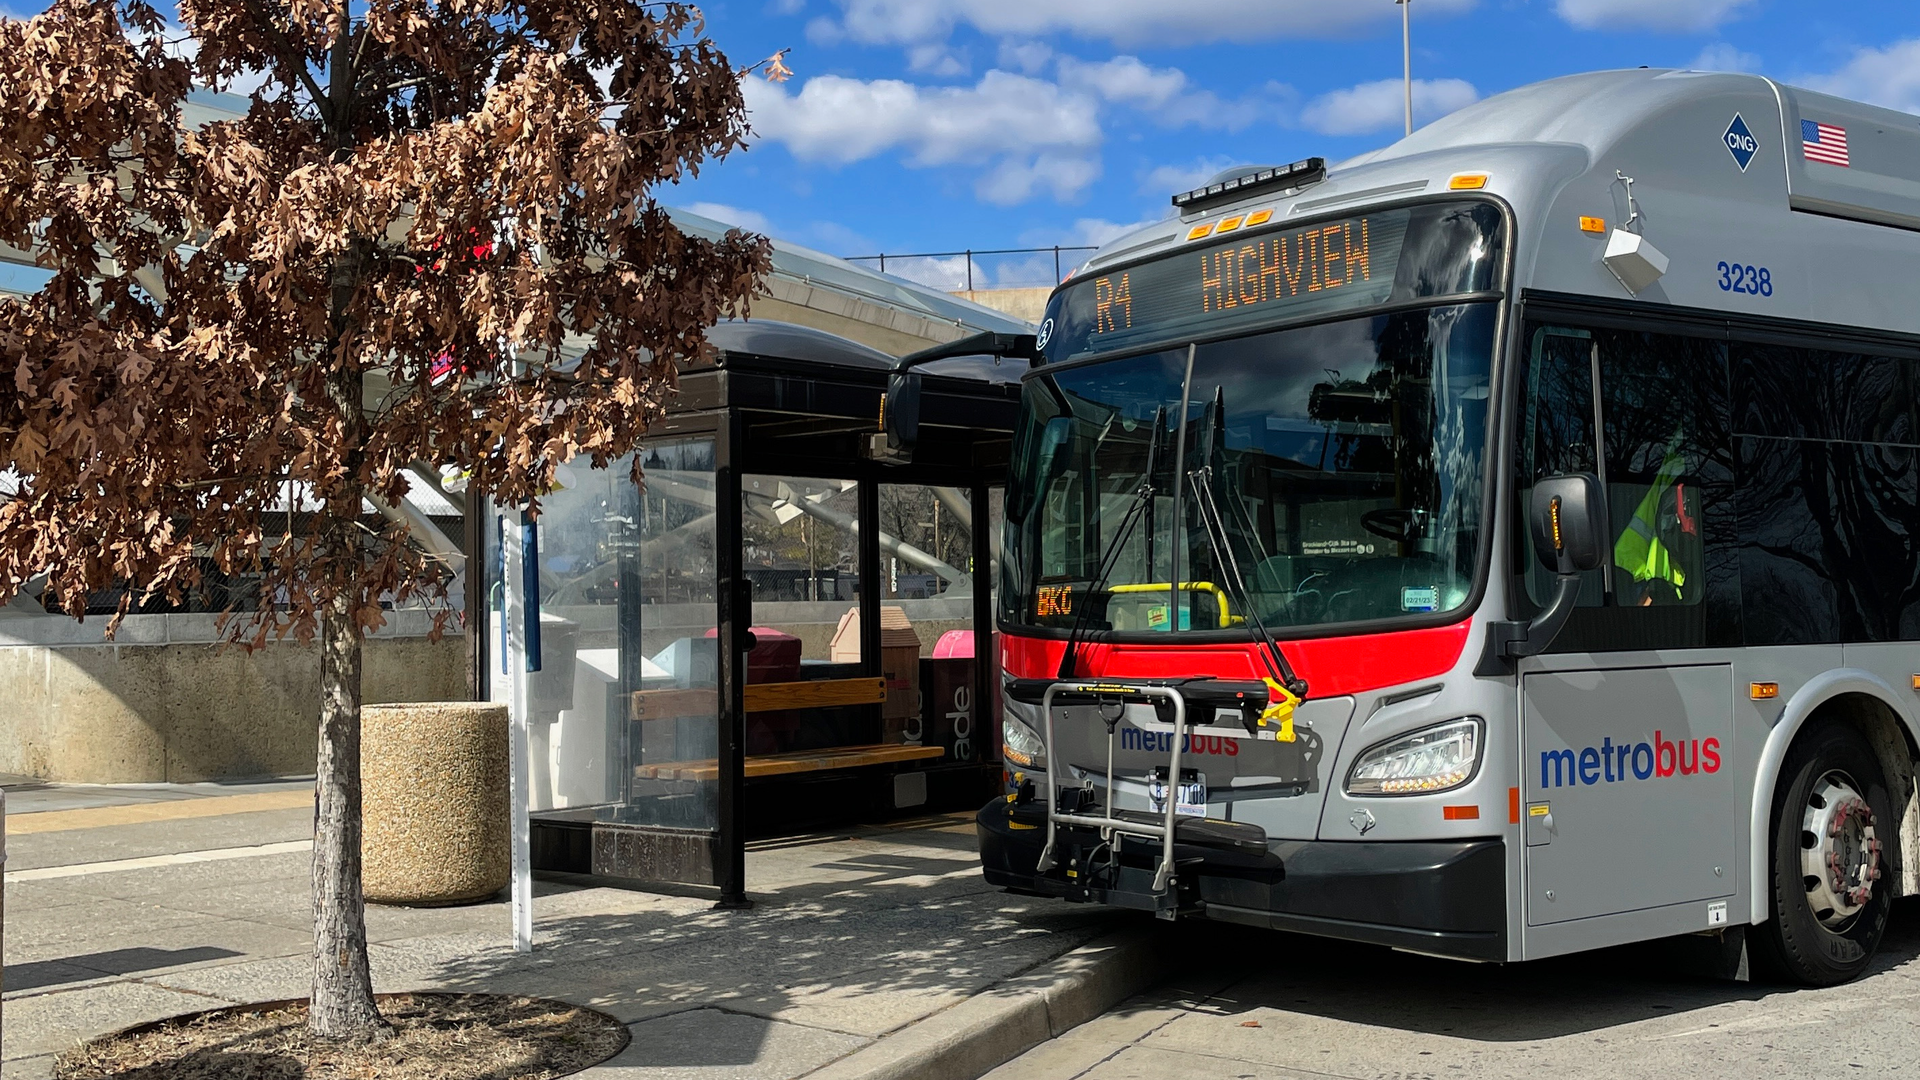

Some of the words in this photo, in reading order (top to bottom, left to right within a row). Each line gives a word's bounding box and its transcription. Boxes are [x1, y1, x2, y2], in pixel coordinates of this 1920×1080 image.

[1727, 132, 1755, 152] CNG
[1095, 272, 1133, 334] R4
[1201, 218, 1370, 313] HIGHVIEW
[1717, 261, 1774, 298] 3238
[1541, 730, 1721, 789] metrobus
[1176, 783, 1206, 805] 7108
